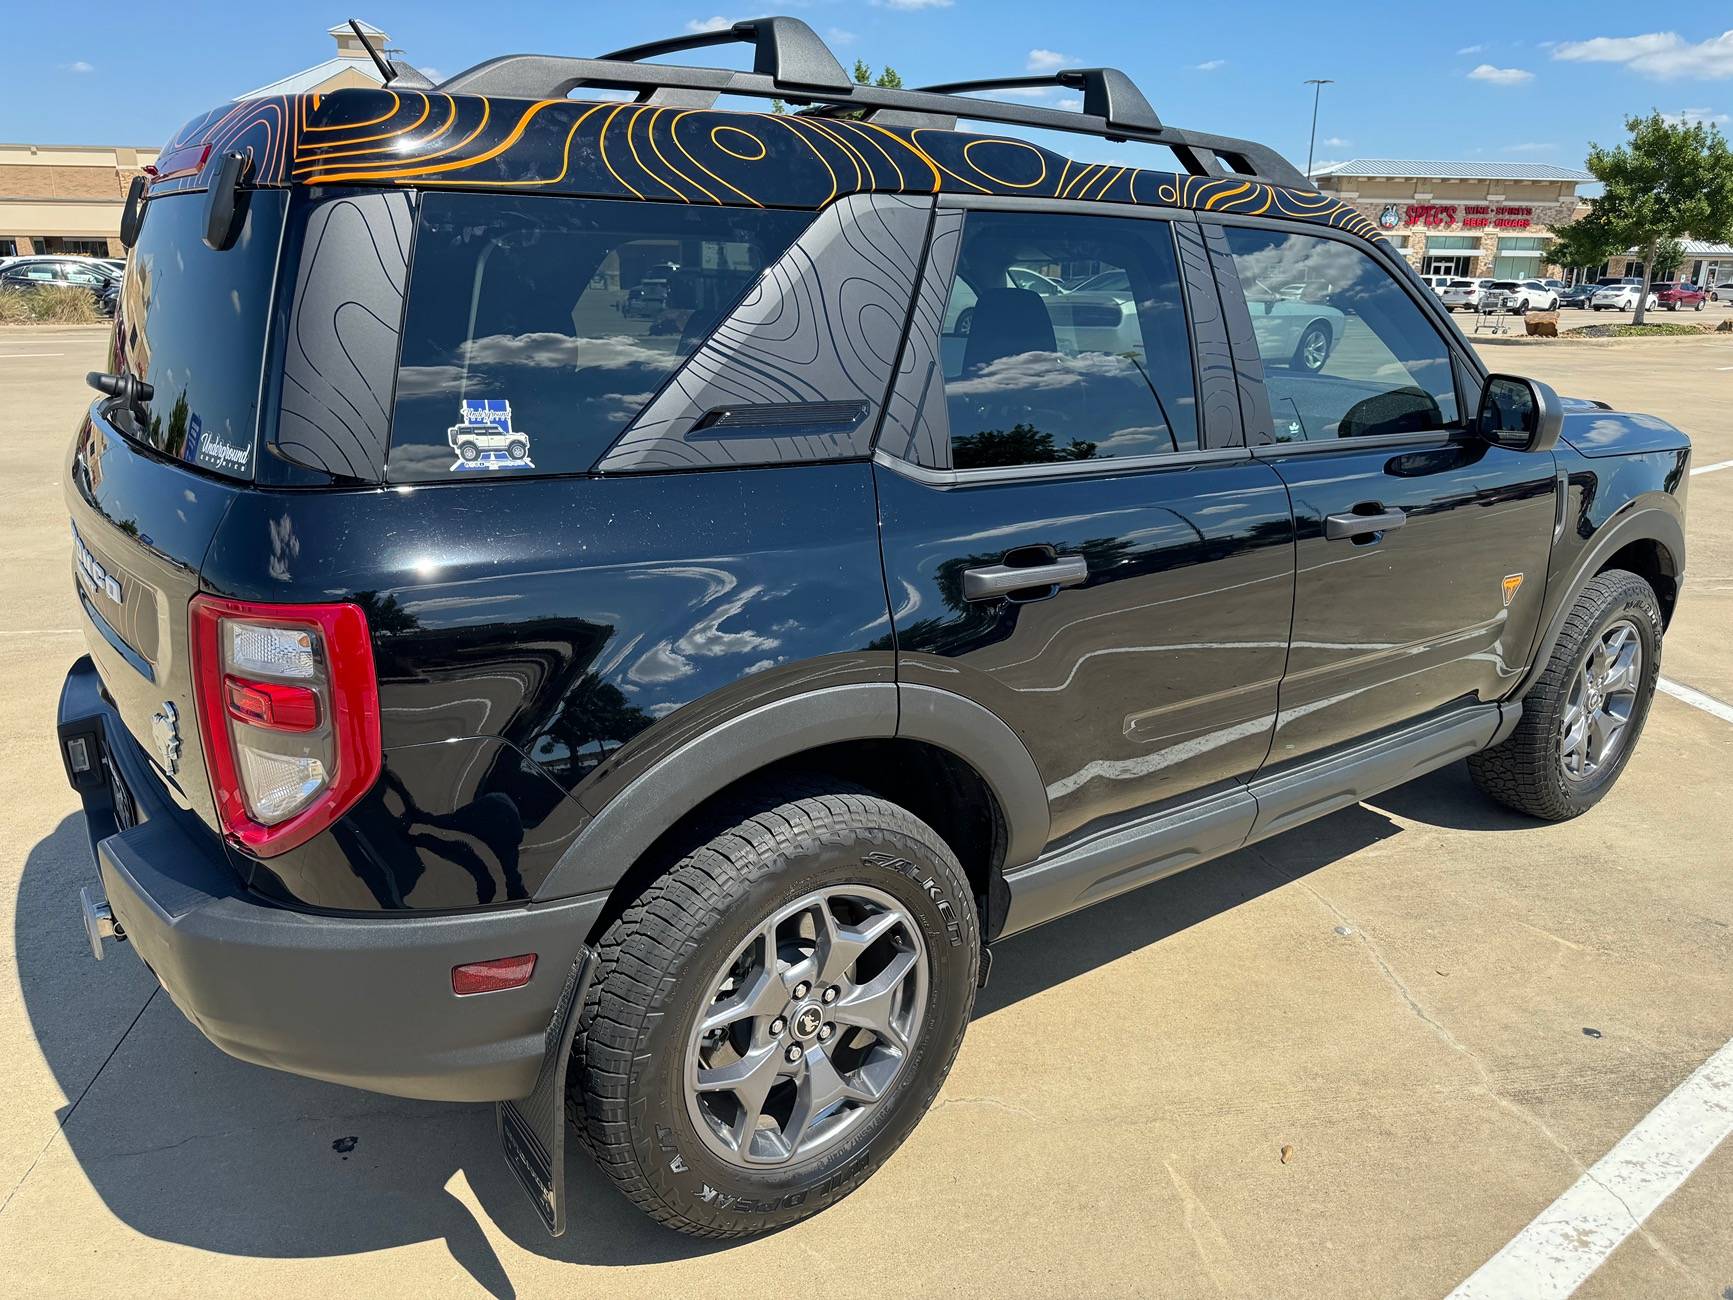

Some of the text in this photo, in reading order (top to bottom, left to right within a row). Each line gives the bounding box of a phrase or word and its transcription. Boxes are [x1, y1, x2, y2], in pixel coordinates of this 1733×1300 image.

[1405, 204, 1457, 226] SPEC'S
[1464, 206, 1532, 216] WINE SPIRITS
[1463, 217, 1530, 228] BEER CIGARS
[200, 432, 251, 468] Underground
[860, 851, 963, 947] FALKEN
